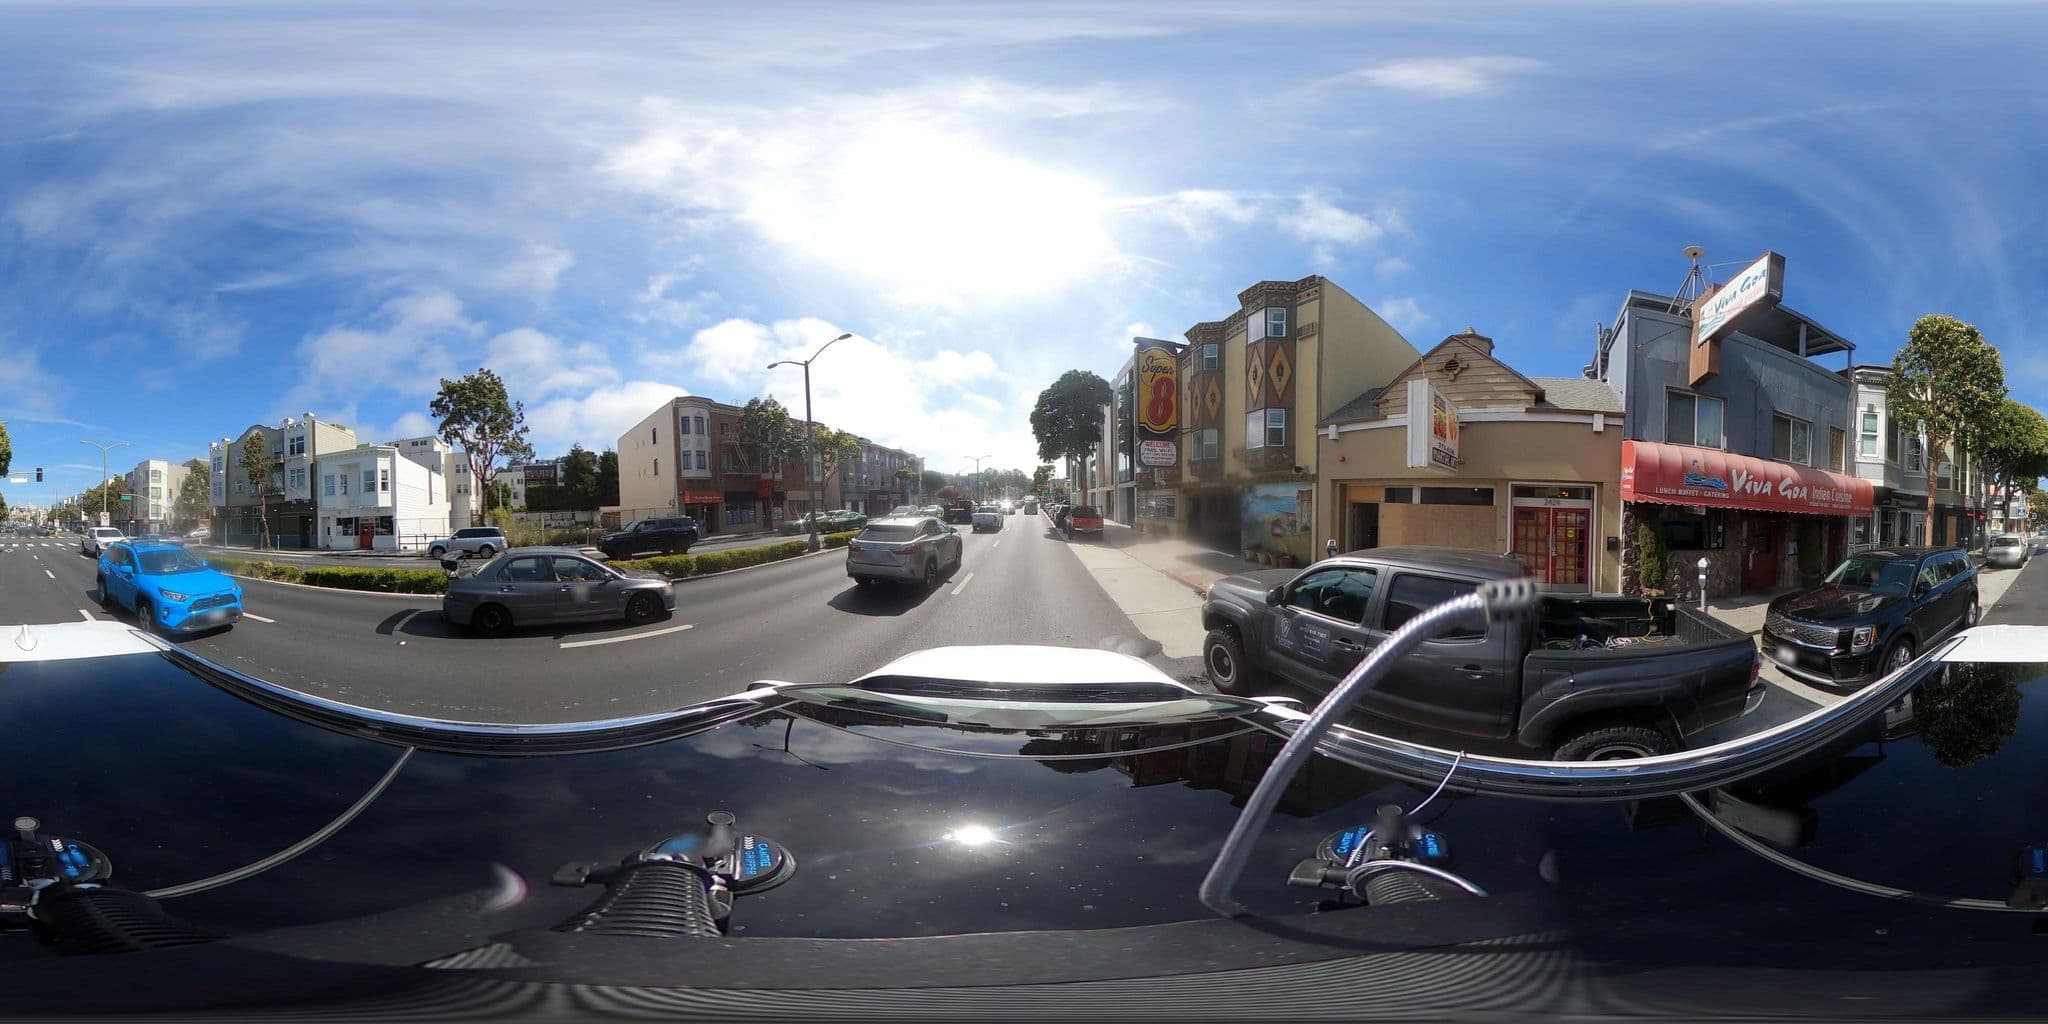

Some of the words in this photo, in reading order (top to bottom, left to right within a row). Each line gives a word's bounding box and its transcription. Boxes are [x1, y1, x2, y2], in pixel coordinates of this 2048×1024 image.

[1715, 290, 1737, 313] Viva
[1740, 269, 1766, 293] Goa
[1141, 356, 1175, 383] Super
[1147, 377, 1174, 425] 8
[1703, 490, 1729, 499] CATERING
[1731, 469, 1773, 496] Viva
[1778, 477, 1808, 500] Goa
[1812, 485, 1830, 500] Indian
[1831, 487, 1852, 503] Cuisine
